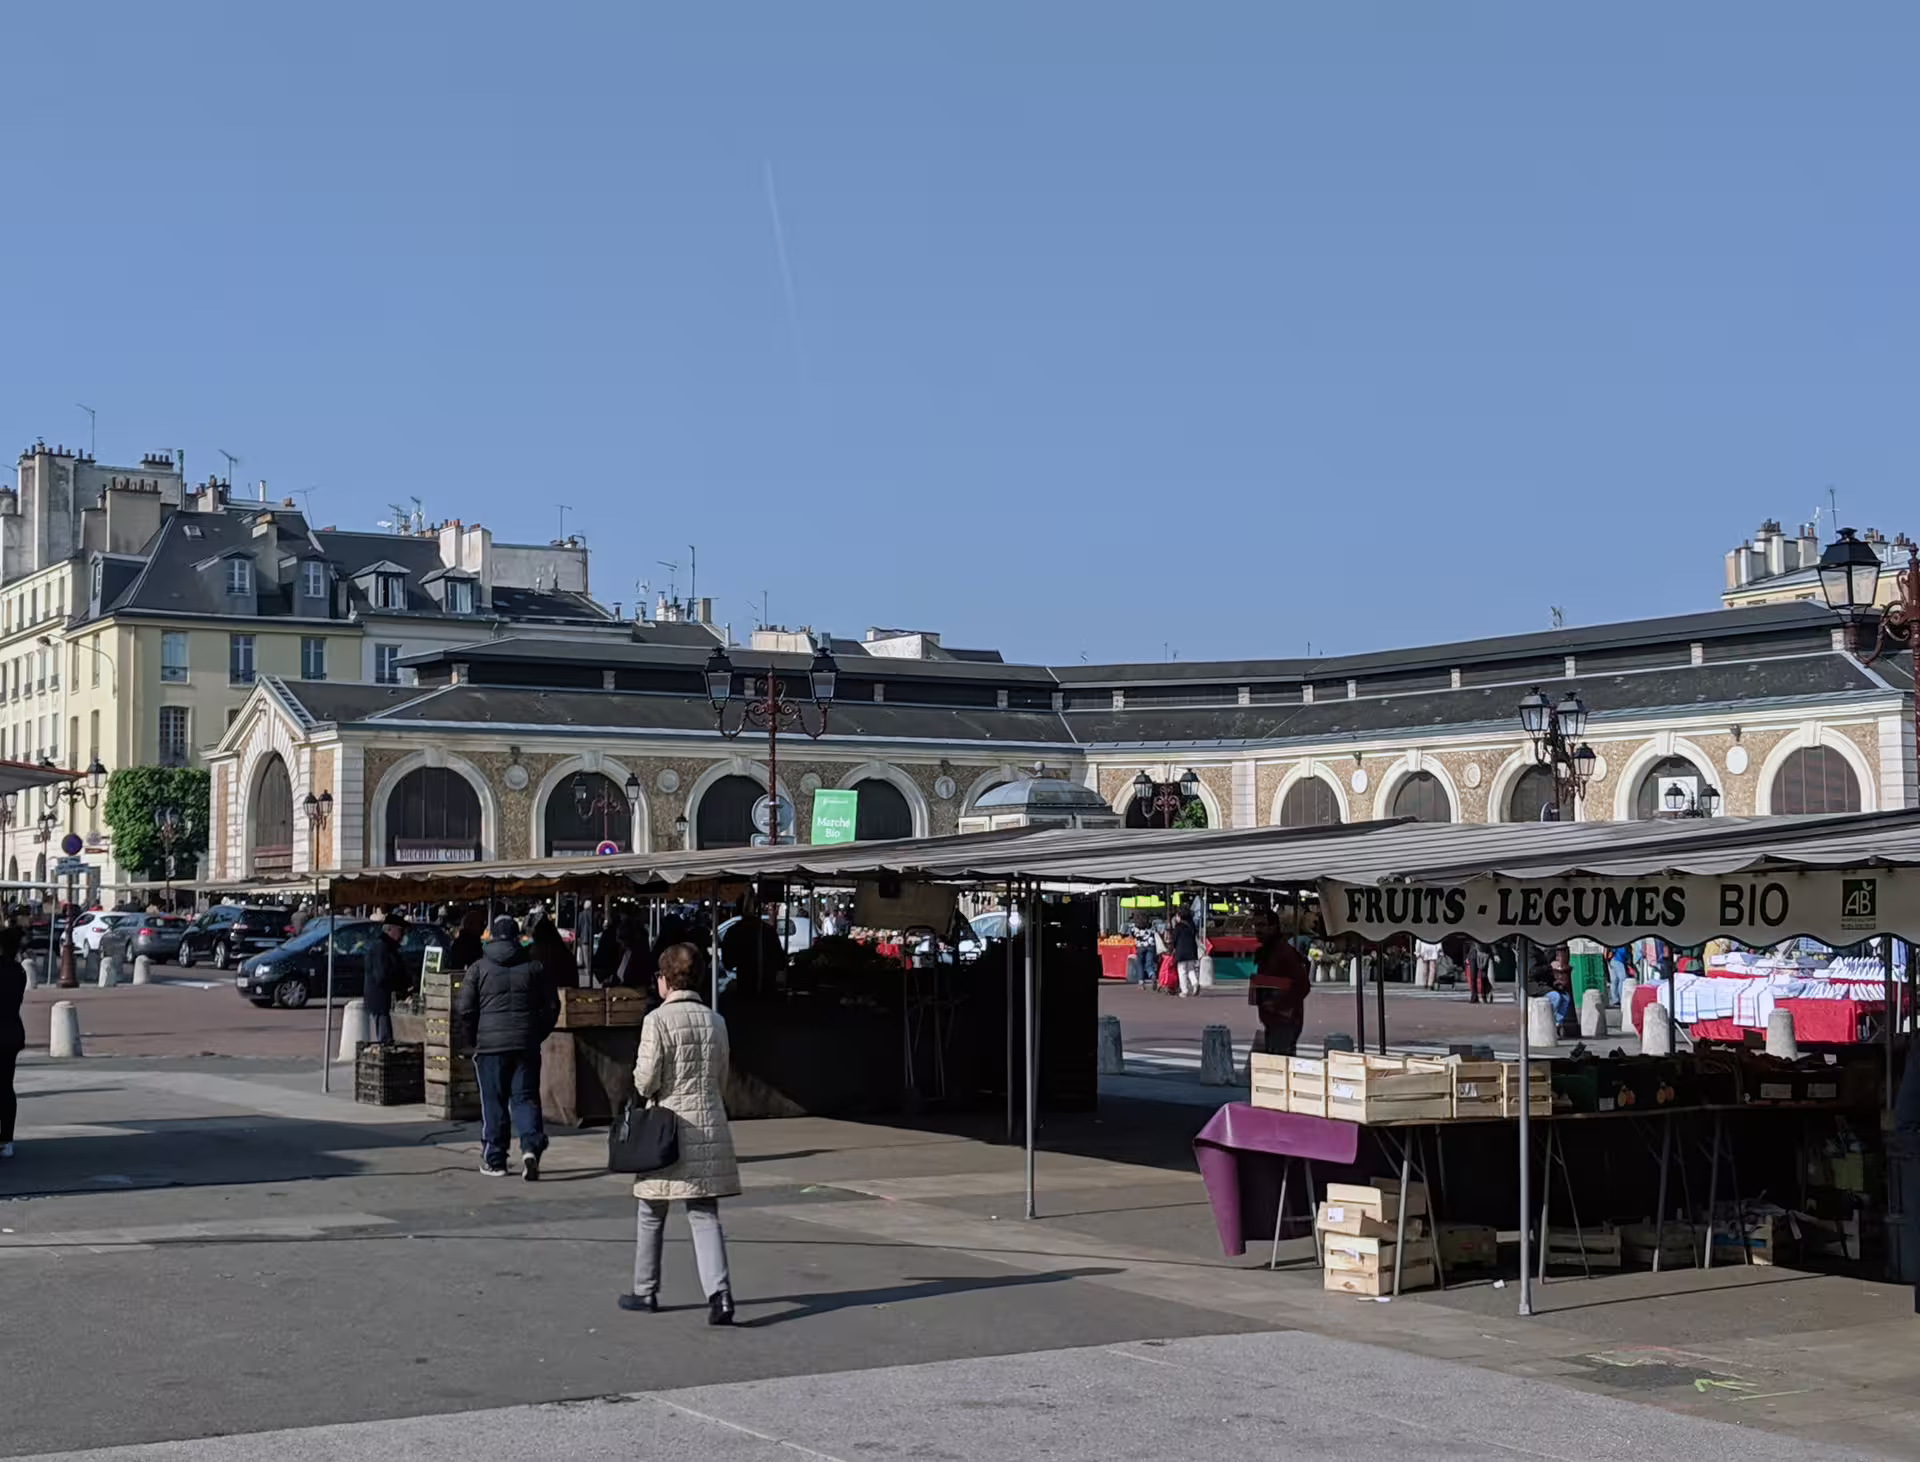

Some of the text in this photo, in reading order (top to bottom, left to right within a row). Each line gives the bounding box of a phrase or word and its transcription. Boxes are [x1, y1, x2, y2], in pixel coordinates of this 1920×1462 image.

[825, 828, 840, 838] Bio
[1344, 887, 1467, 924] FRUITS
[1497, 886, 1686, 927] LEGUMES
[1719, 882, 1790, 927] BIO
[1844, 889, 1873, 915] AB
